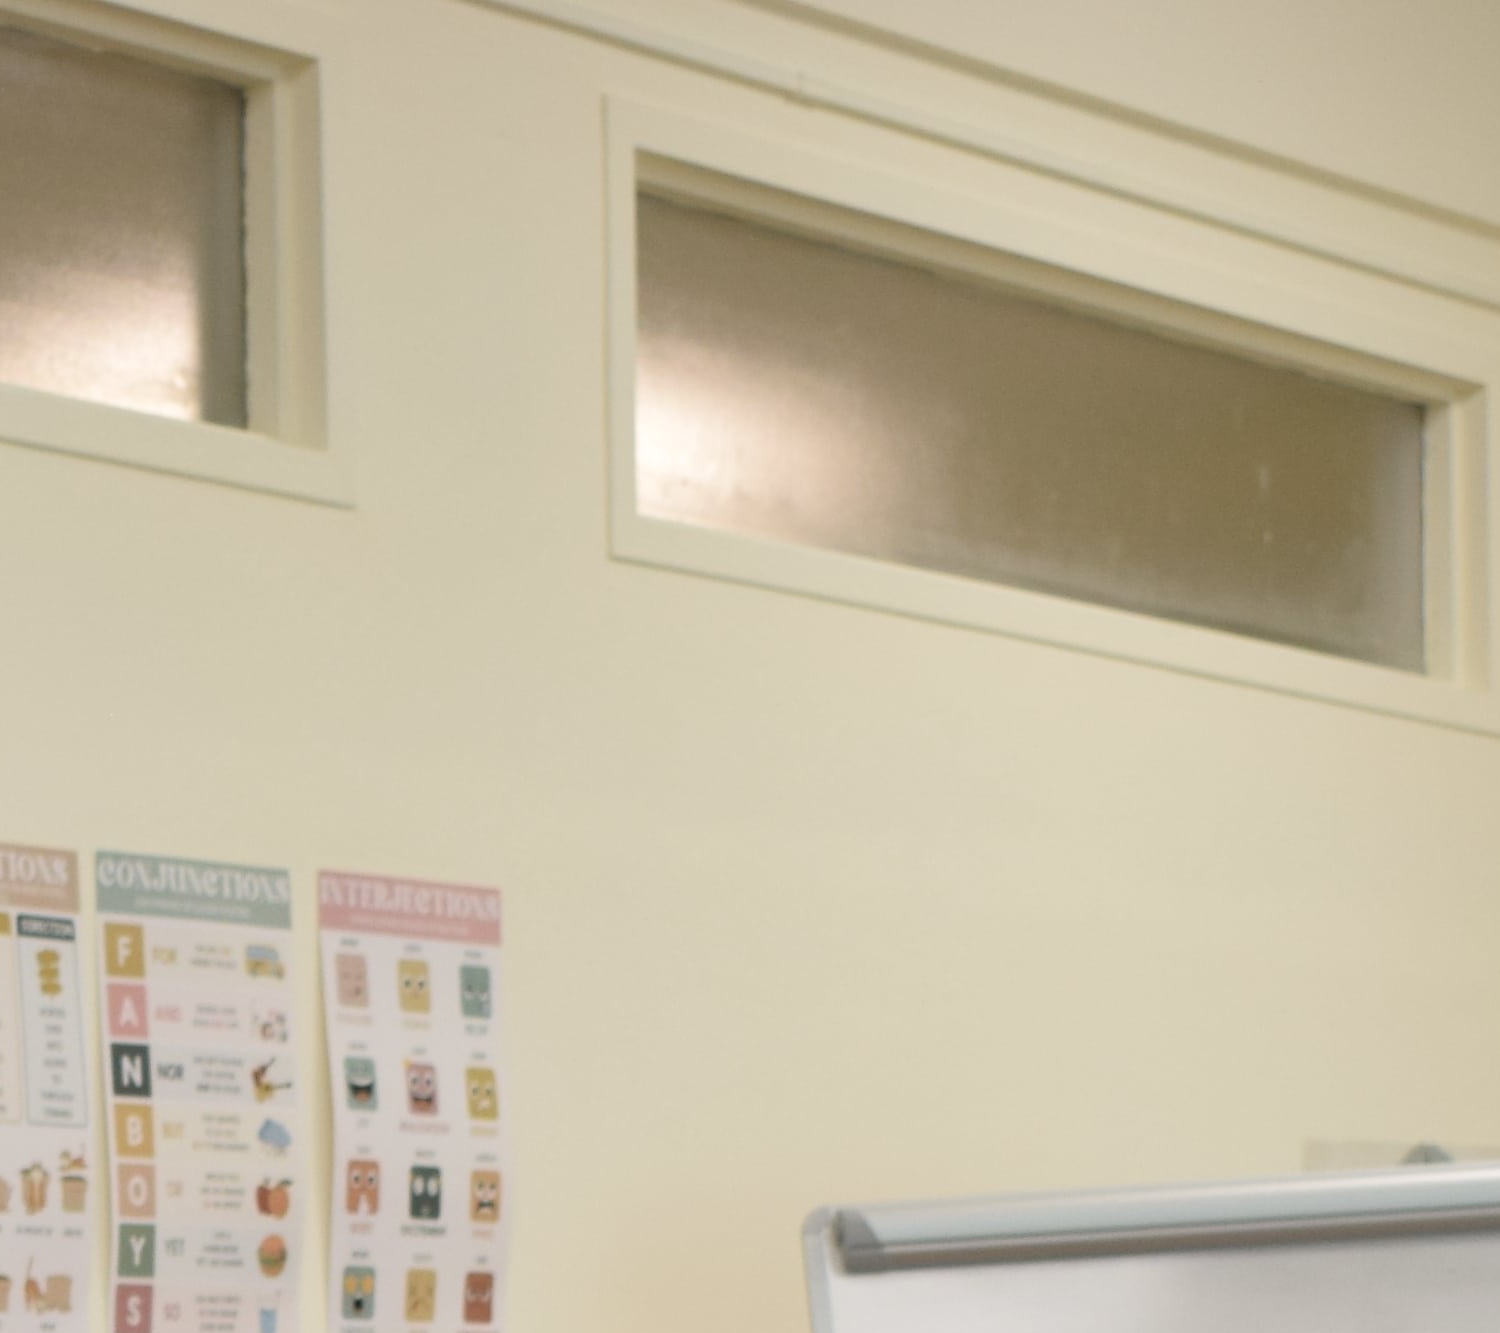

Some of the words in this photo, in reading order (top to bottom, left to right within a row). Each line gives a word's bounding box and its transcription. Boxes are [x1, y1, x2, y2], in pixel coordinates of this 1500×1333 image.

[98, 858, 291, 904] CONJUNCTIONS
[116, 934, 133, 968] F
[119, 995, 140, 1029] A
[120, 1054, 144, 1088] N
[125, 1114, 144, 1147] B
[128, 1175, 146, 1207] O
[128, 1234, 146, 1267] Y
[126, 1294, 142, 1328] S
